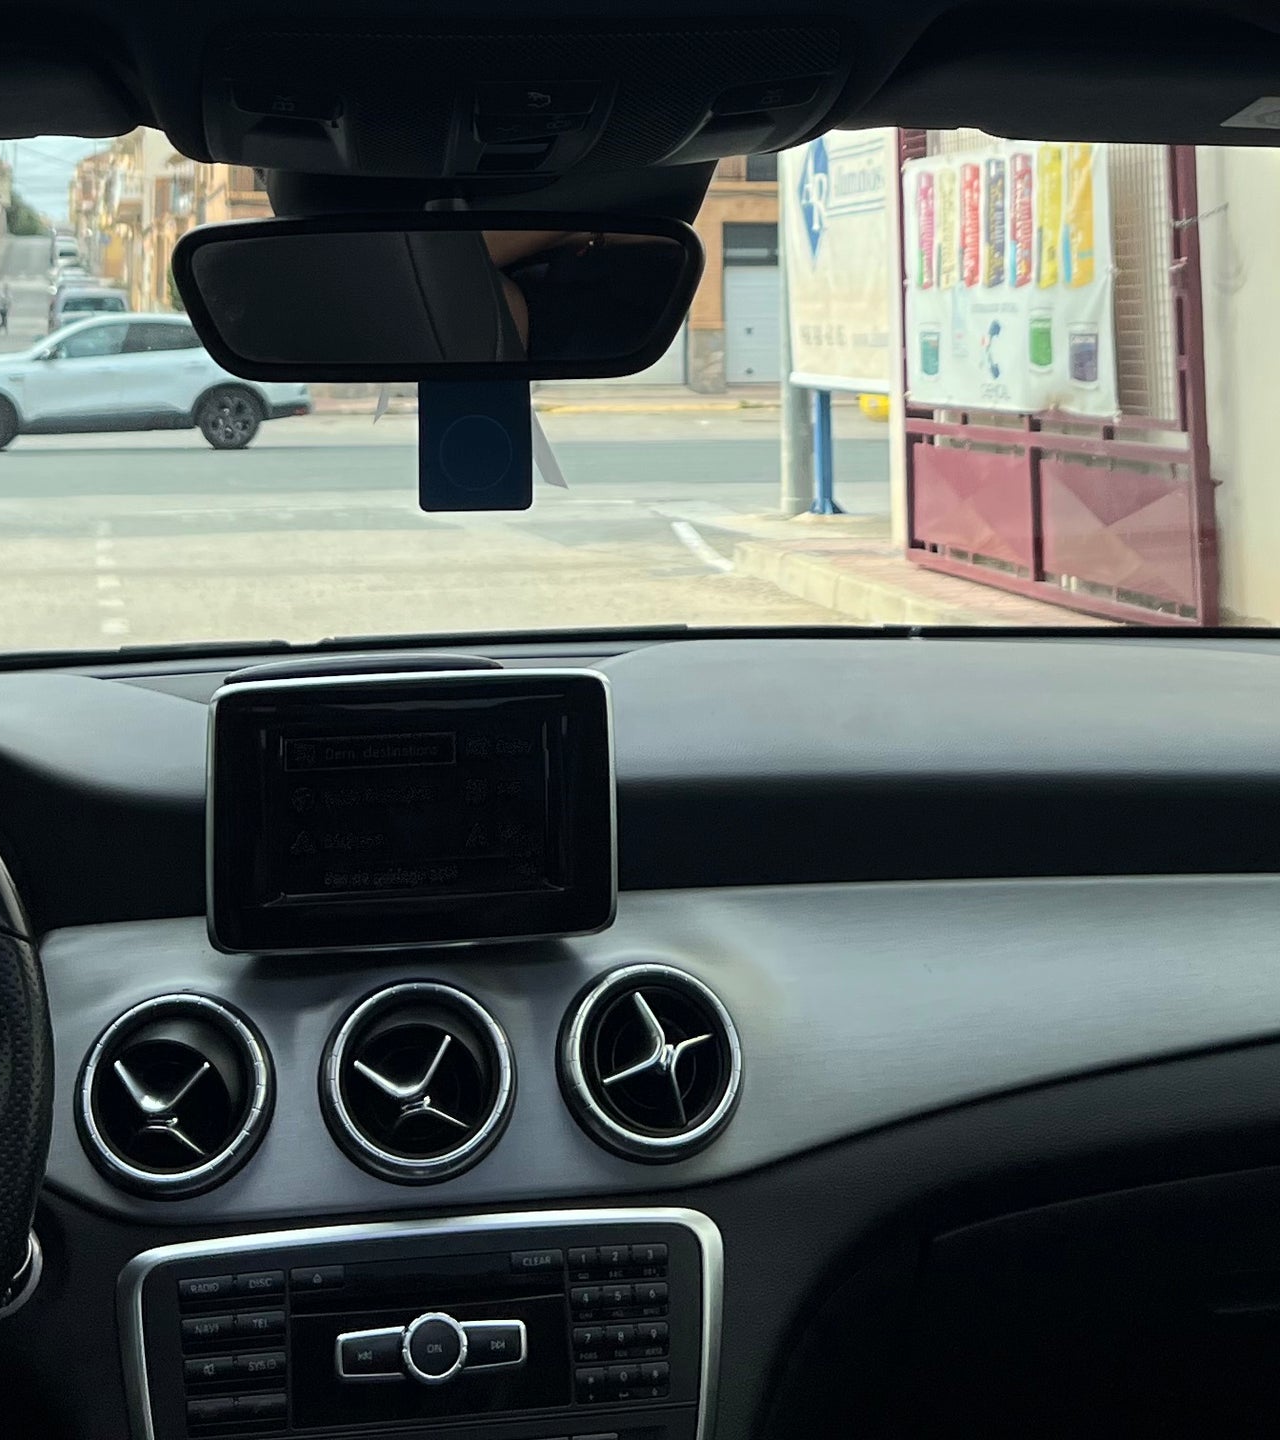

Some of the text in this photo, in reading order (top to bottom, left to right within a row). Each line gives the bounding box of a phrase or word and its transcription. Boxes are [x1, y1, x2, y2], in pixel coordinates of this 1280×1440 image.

[522, 1256, 551, 1266] CLEAR
[190, 1283, 219, 1293] RADIO
[248, 1278, 272, 1288] DISC
[426, 1343, 442, 1354] ON
[248, 1360, 266, 1371] SYS
